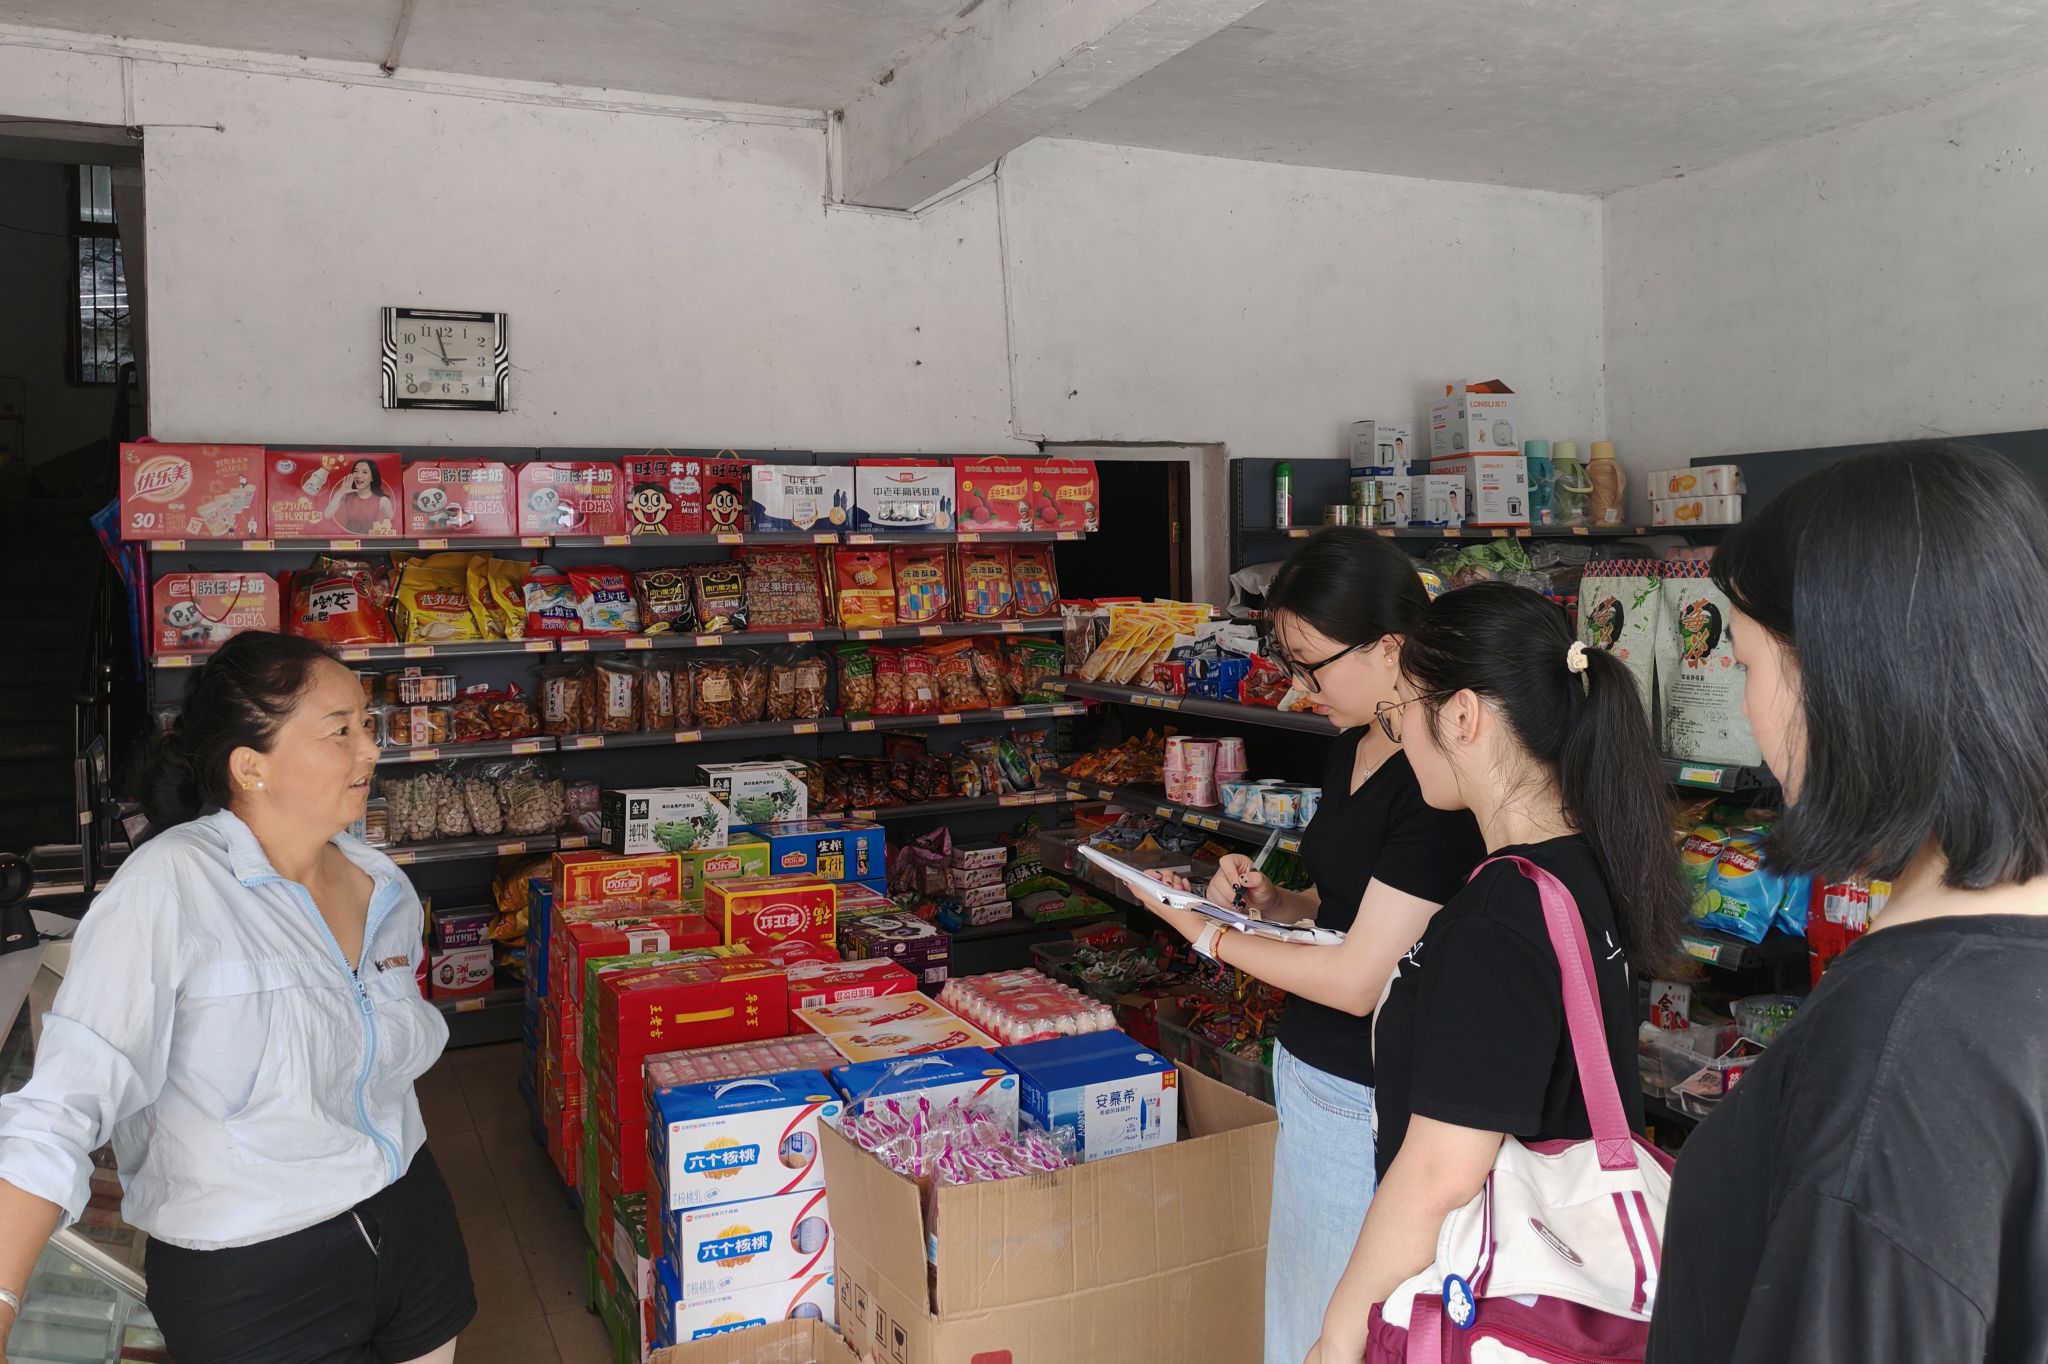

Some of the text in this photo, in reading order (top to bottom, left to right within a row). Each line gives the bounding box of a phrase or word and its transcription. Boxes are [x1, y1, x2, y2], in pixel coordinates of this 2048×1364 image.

[421, 326, 431, 337] 11
[439, 327, 453, 338] 12
[462, 328, 467, 339] 1
[403, 333, 416, 345] 10
[477, 336, 486, 347] 2
[405, 353, 414, 364] 9
[477, 356, 486, 367] 3
[405, 373, 414, 384] 8
[442, 383, 450, 394] 6
[461, 384, 470, 394] 5
[634, 461, 700, 476] 旺仔牛奶
[785, 486, 823, 496] 高钙低糖
[872, 488, 940, 497] 中老年高钙低糖
[586, 501, 613, 512] DHA
[131, 512, 156, 529] 30
[759, 582, 806, 594] 坚果时刻
[233, 613, 266, 626] DHA
[631, 801, 648, 814] 金典
[818, 839, 843, 853] 生榨
[707, 859, 738, 872] 欢乐家
[819, 858, 843, 873] 椰子汁
[607, 878, 638, 890] 欢乐家
[745, 992, 758, 1027] 王老吉
[650, 1004, 663, 1040] 王老吉
[1096, 1088, 1135, 1110] 安慕希
[689, 1147, 755, 1171] 六个核桃
[702, 1234, 768, 1260] 六个核桃
